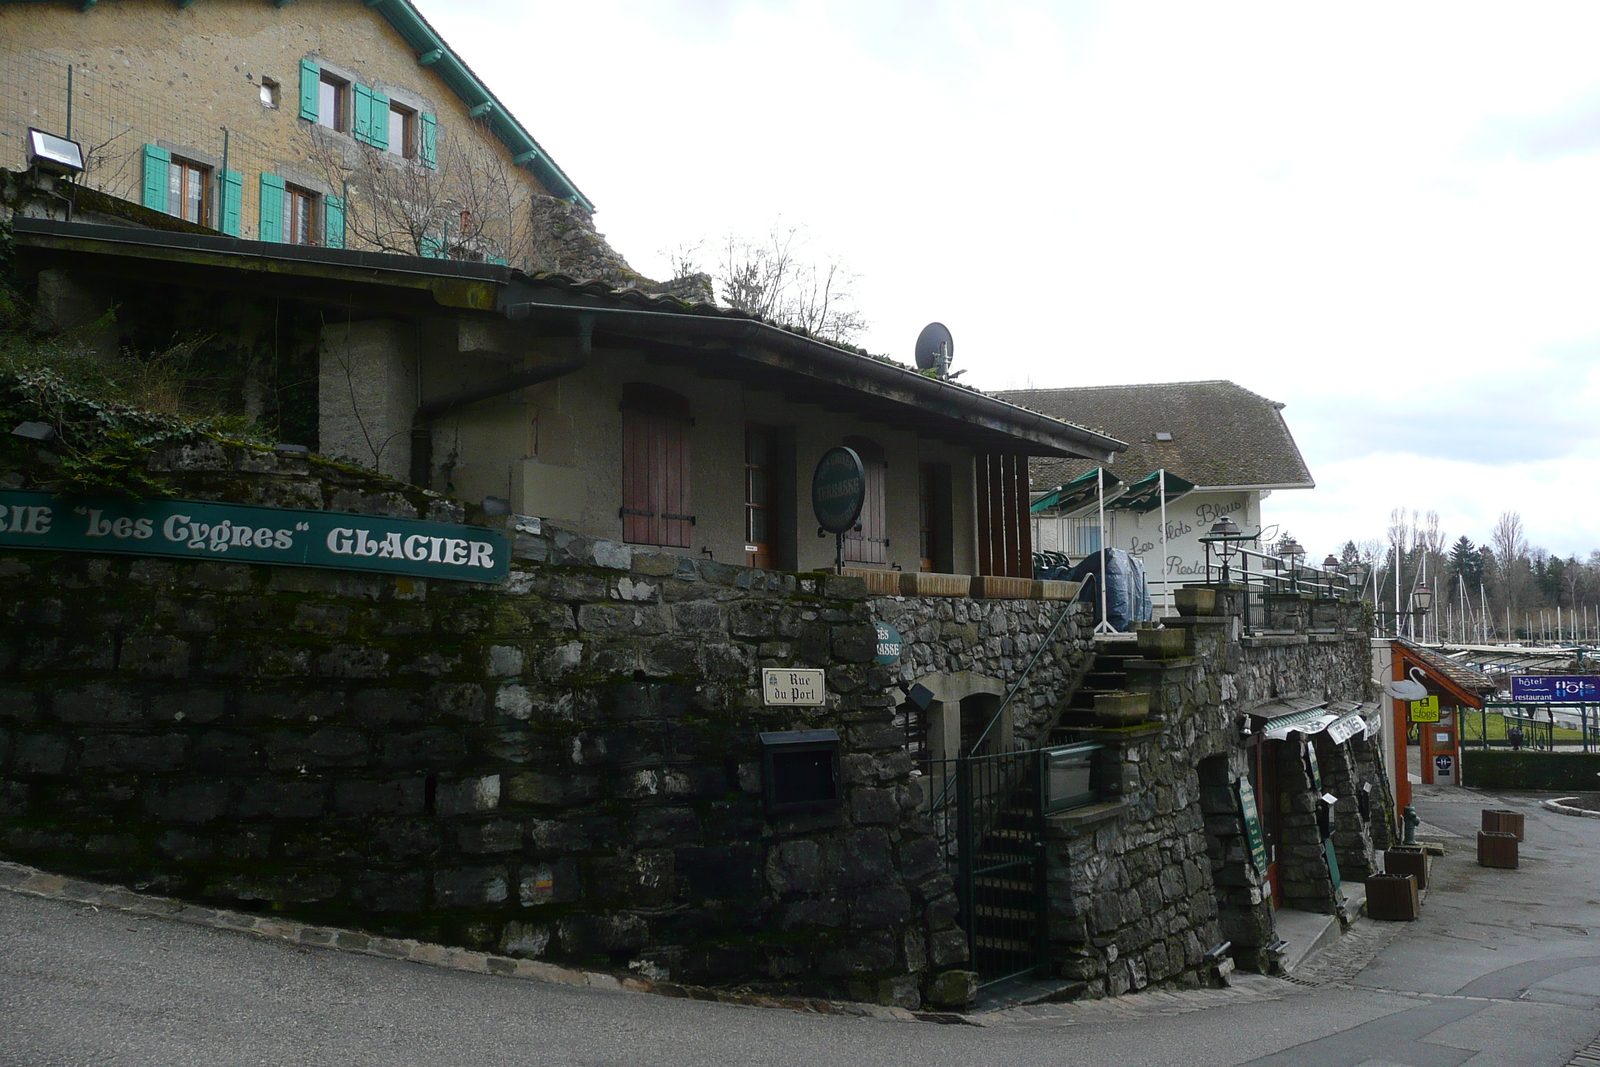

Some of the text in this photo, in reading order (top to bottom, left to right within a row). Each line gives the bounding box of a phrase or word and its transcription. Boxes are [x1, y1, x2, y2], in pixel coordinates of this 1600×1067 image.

[816, 477, 860, 502] TERRASSE
[1128, 536, 1154, 556] Les
[1196, 501, 1242, 527] Bleus
[326, 525, 496, 569] GLACIER
[789, 673, 811, 686] Rue
[1518, 677, 1542, 687] hôtel
[774, 687, 815, 703] du Port
[1413, 707, 1438, 720] Logis
